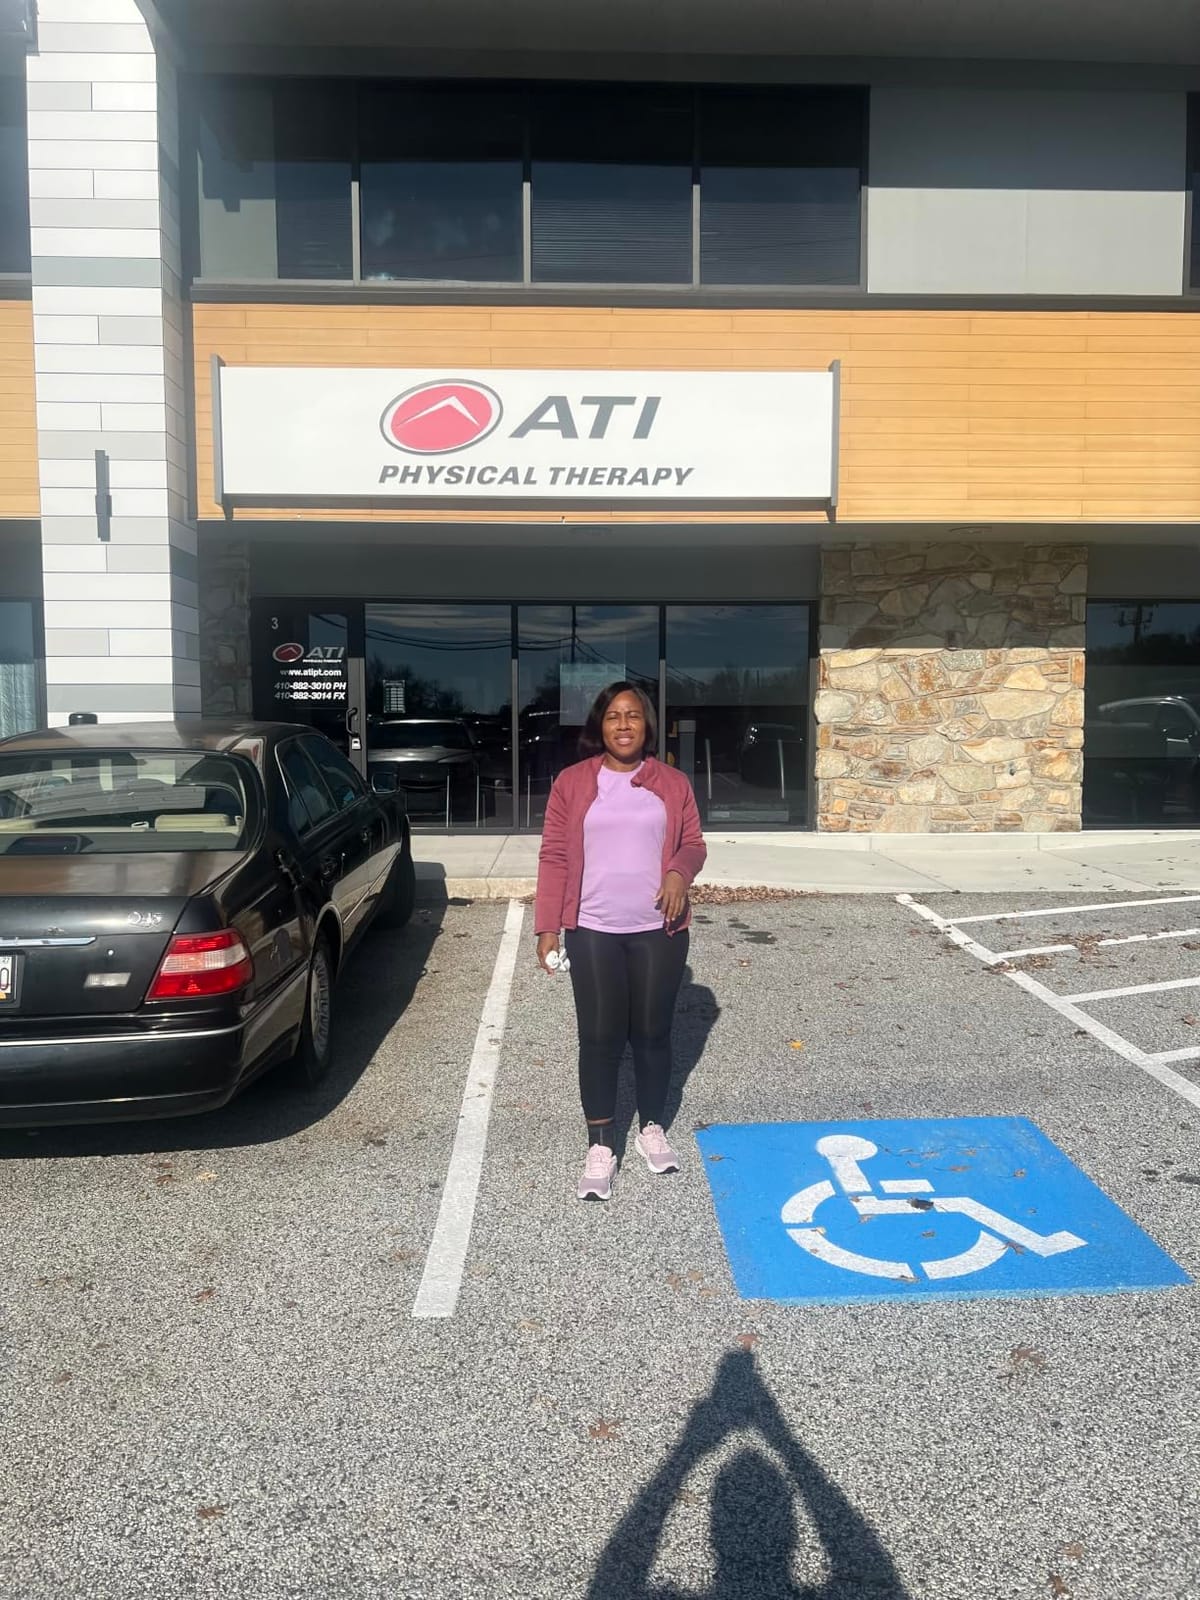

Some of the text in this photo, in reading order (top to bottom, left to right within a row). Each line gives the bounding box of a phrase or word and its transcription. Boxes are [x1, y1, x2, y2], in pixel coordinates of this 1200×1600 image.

[509, 395, 662, 439] ATI
[378, 464, 695, 486] PHYSICAL THERAPY
[271, 617, 279, 629] 3
[306, 646, 345, 658] ATI
[280, 668, 342, 677] www.atipt.com
[274, 681, 347, 690] 410-882-3010 PH
[274, 691, 346, 700] 410-882-3014 FX
